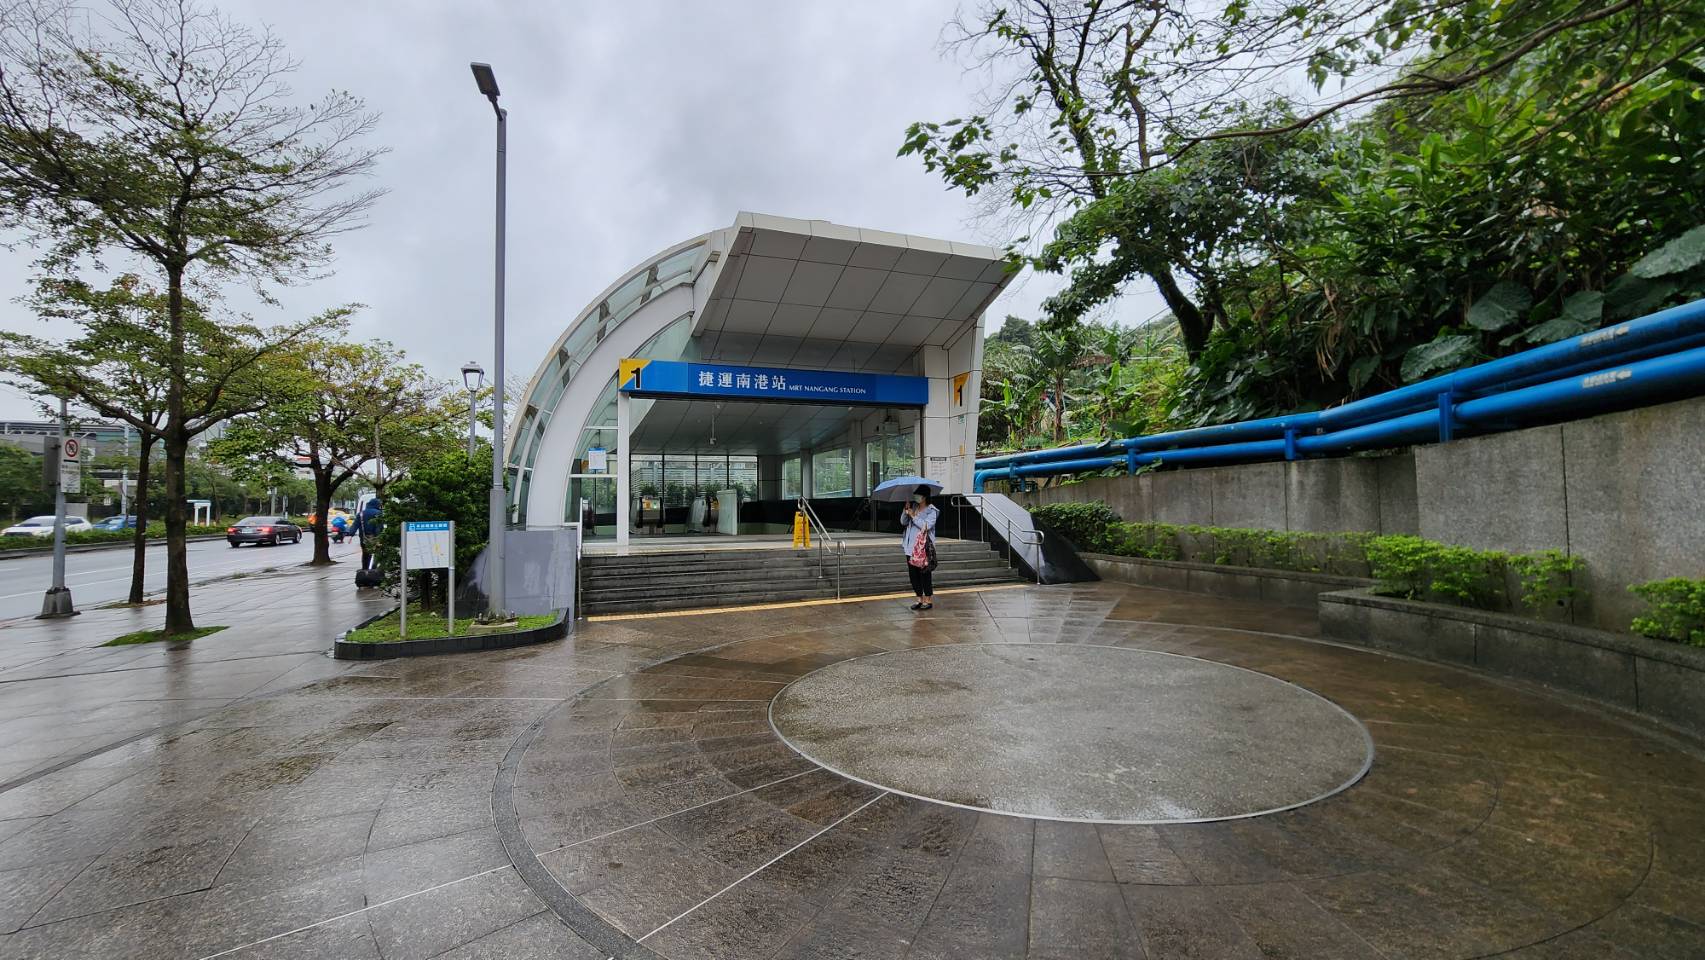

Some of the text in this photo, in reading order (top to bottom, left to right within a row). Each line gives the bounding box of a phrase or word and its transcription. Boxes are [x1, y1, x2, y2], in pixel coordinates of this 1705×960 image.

[630, 367, 642, 390] 1
[698, 370, 786, 391] 捷運南港站
[804, 385, 839, 393] NANGANG
[839, 386, 866, 394] STATION
[957, 384, 963, 407] 1
